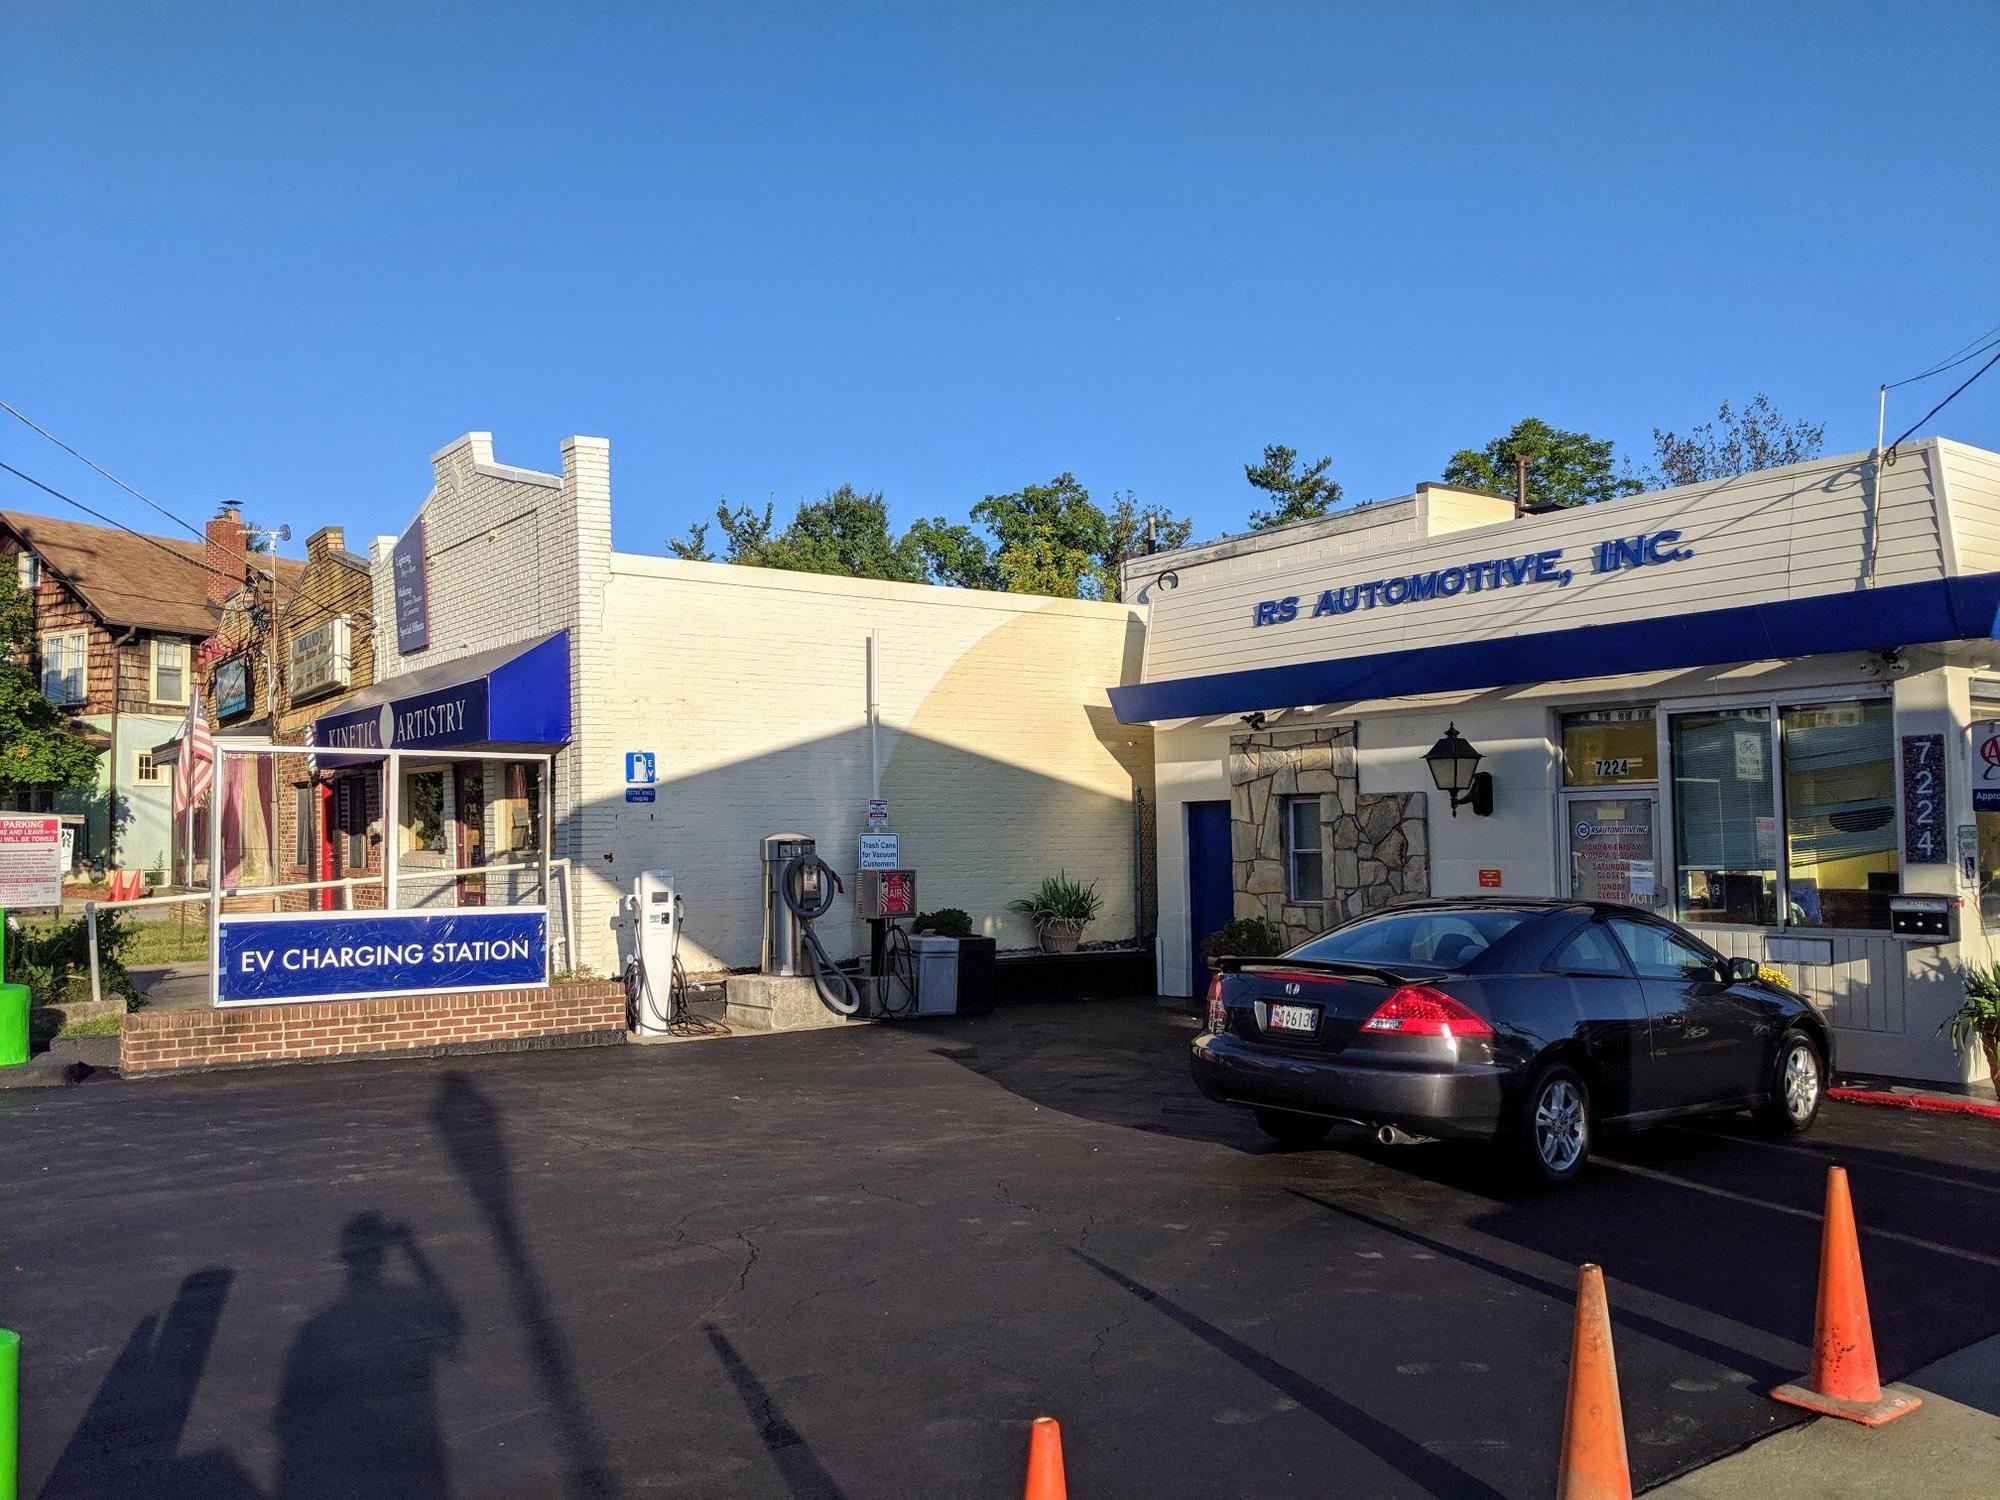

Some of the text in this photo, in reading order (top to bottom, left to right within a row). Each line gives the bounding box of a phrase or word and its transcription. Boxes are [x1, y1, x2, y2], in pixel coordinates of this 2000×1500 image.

[1255, 530, 1695, 627] RS AUTOMOTIVE, INC.
[328, 700, 466, 748] KINETIC ARTISTRY
[1595, 758, 1629, 776] 7224
[3, 820, 44, 829] PARKING
[862, 841, 897, 849] Trash Cans
[862, 850, 897, 858] for Vacuum
[862, 860, 896, 868] Customers
[1591, 862, 1630, 871] SATURDAY
[1597, 871, 1626, 880] CLOSED
[1597, 882, 1626, 891] SUNDAY
[889, 888, 902, 898] AIR
[1597, 891, 1626, 900] CLOSED
[241, 939, 530, 973] EV CHARGING STATION
